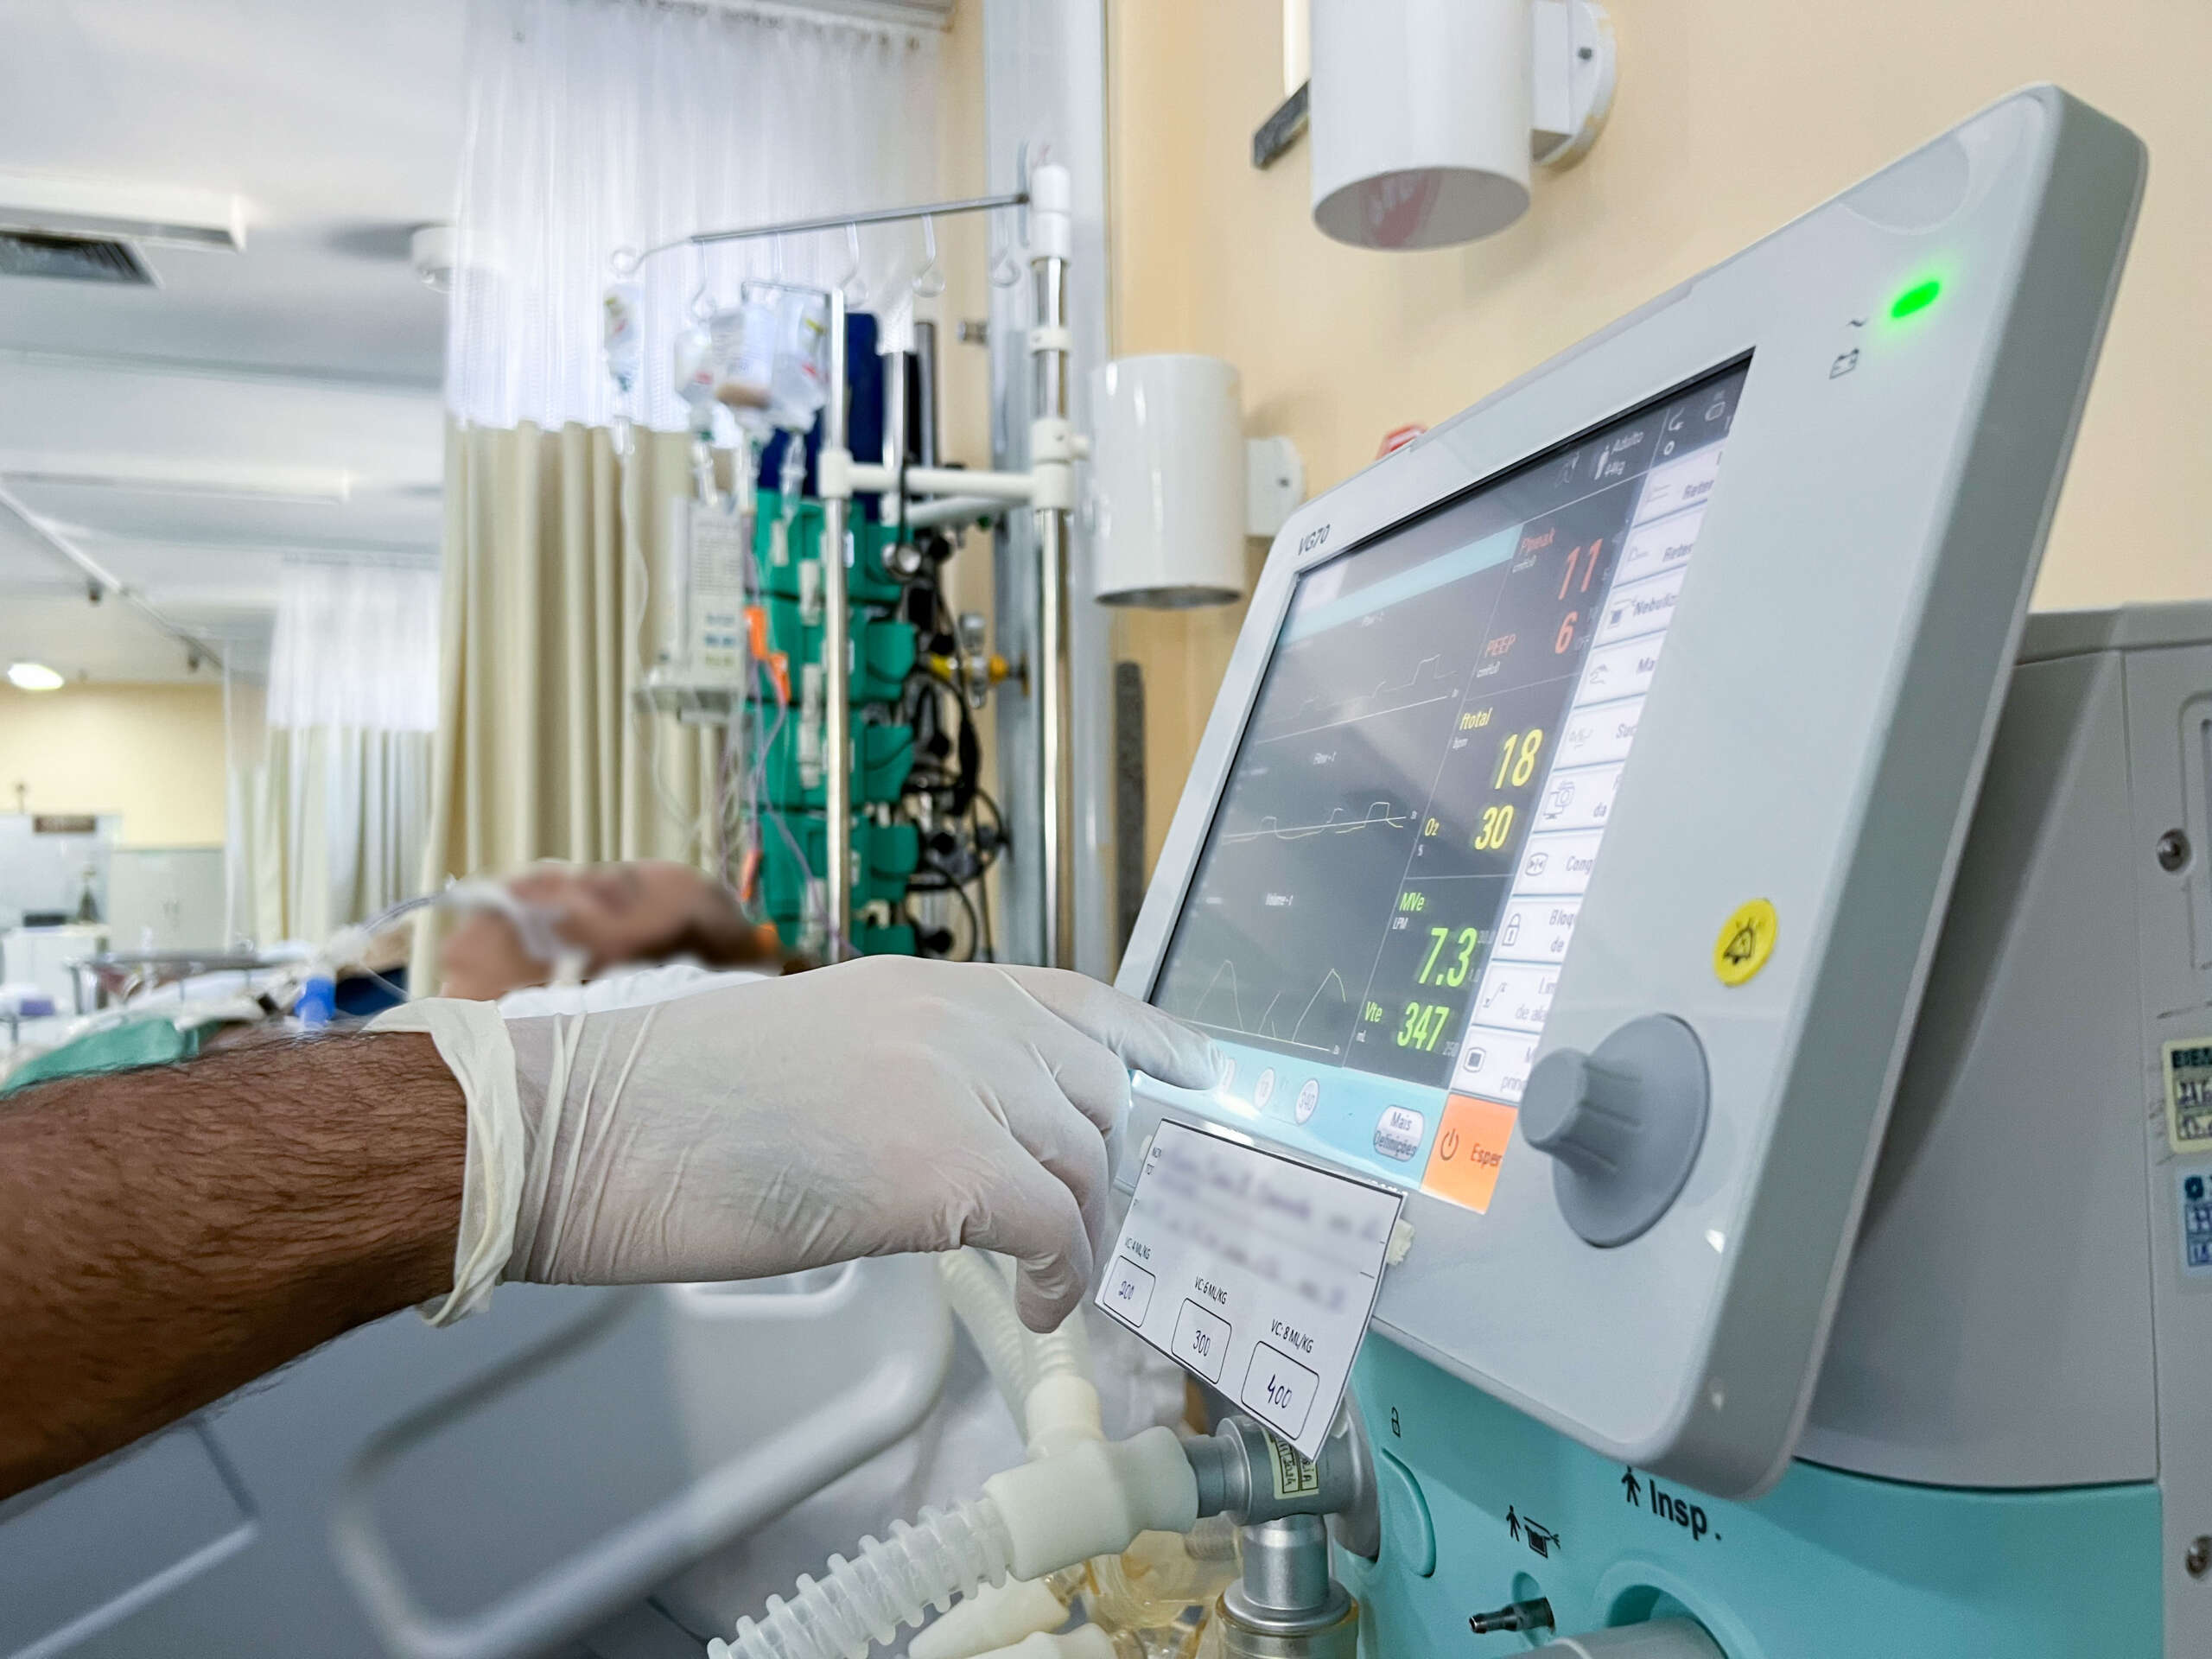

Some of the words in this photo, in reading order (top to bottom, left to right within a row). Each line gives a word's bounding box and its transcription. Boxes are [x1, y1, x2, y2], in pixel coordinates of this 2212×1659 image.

[1298, 524, 1331, 556] VG70
[1558, 538, 1604, 600] 11
[1485, 633, 1516, 657] PEEP
[1555, 611, 1578, 654] 6
[1460, 707, 1493, 730] ftotal
[1495, 729, 1543, 790] 18
[1475, 804, 1515, 850] 30
[1399, 892, 1425, 911] MVe
[1419, 927, 1478, 987] 7.3
[1365, 1001, 1382, 1023] Vte
[1397, 1002, 1450, 1052] 347
[1389, 1111, 1413, 1131] Mais
[1192, 1330, 1211, 1357] 300
[1268, 1374, 1293, 1408] 400
[1649, 1478, 1722, 1542] Insp.
